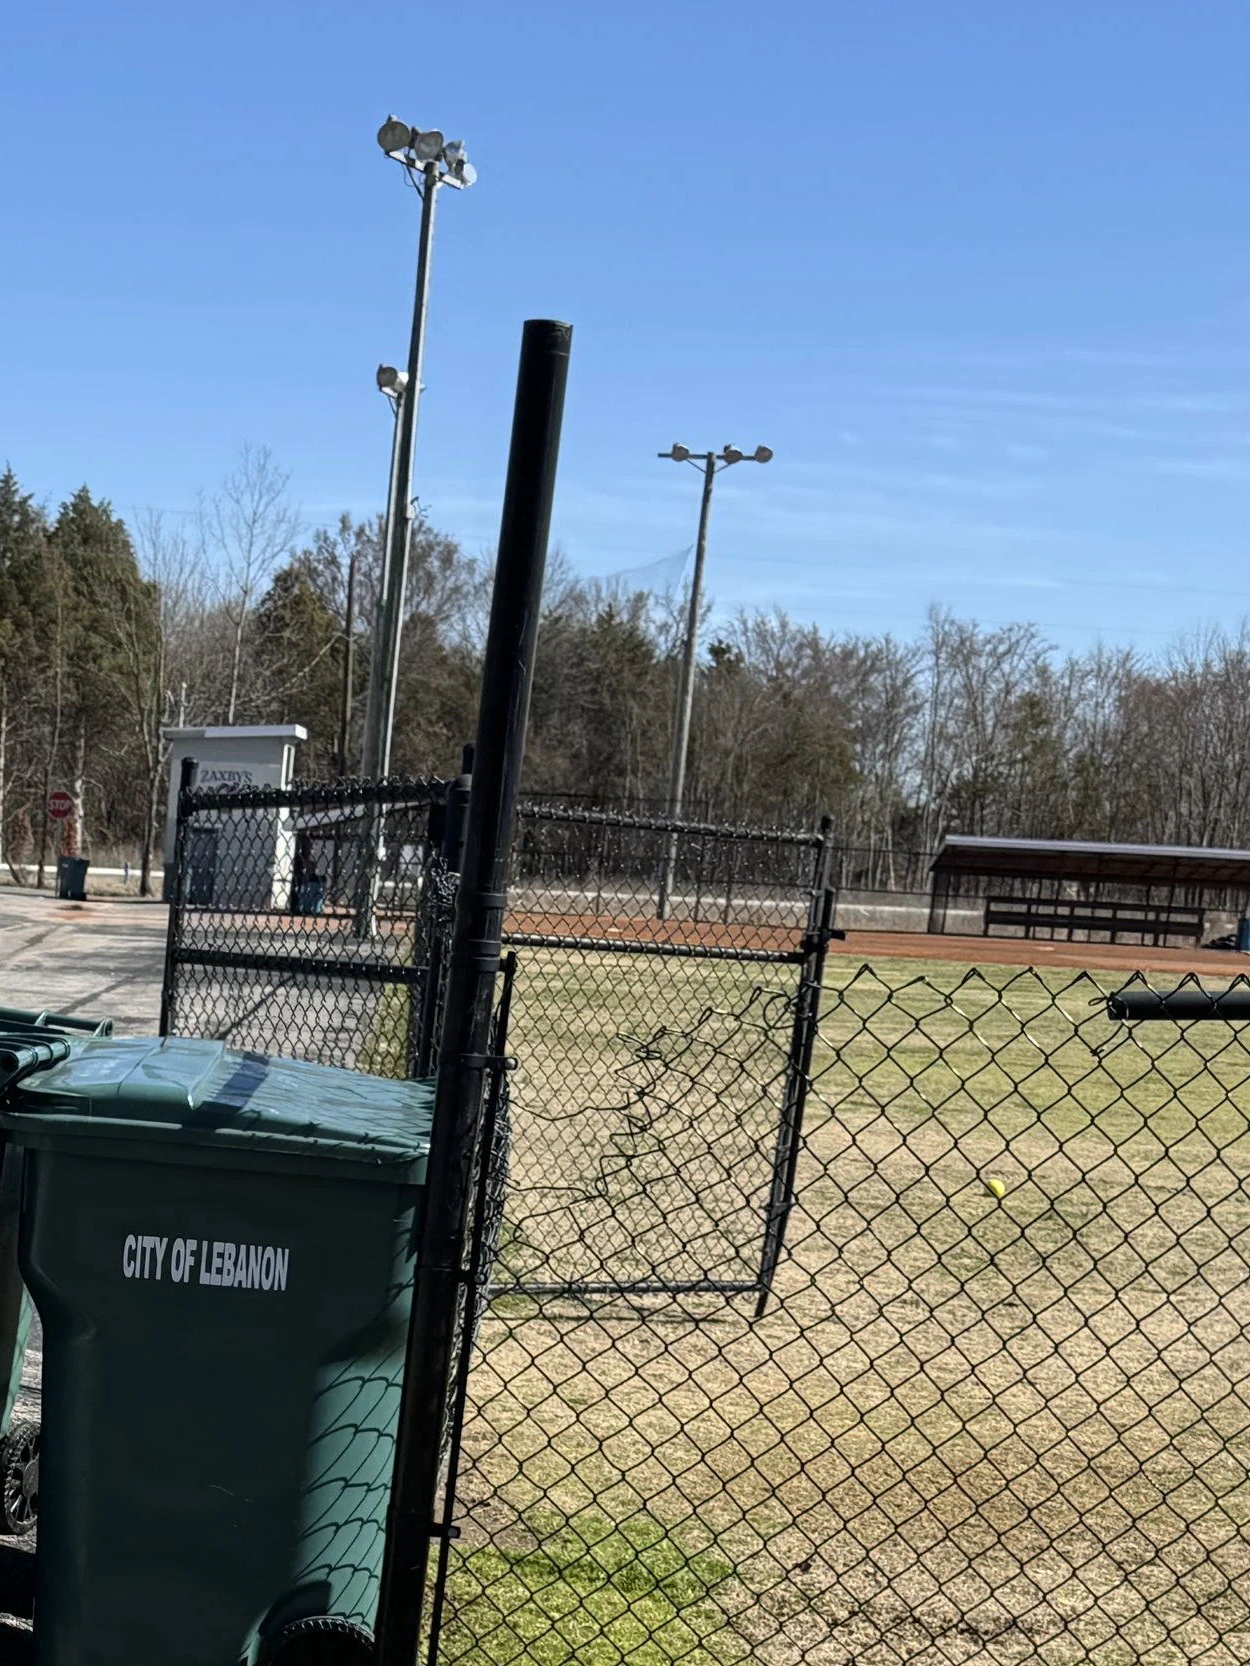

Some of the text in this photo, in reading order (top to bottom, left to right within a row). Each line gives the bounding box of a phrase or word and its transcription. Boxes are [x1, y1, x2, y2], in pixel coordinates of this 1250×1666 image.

[200, 769, 253, 784] ZAXBY'S
[47, 799, 72, 810] STOP
[122, 1233, 290, 1292] CITY OF LEBANON
